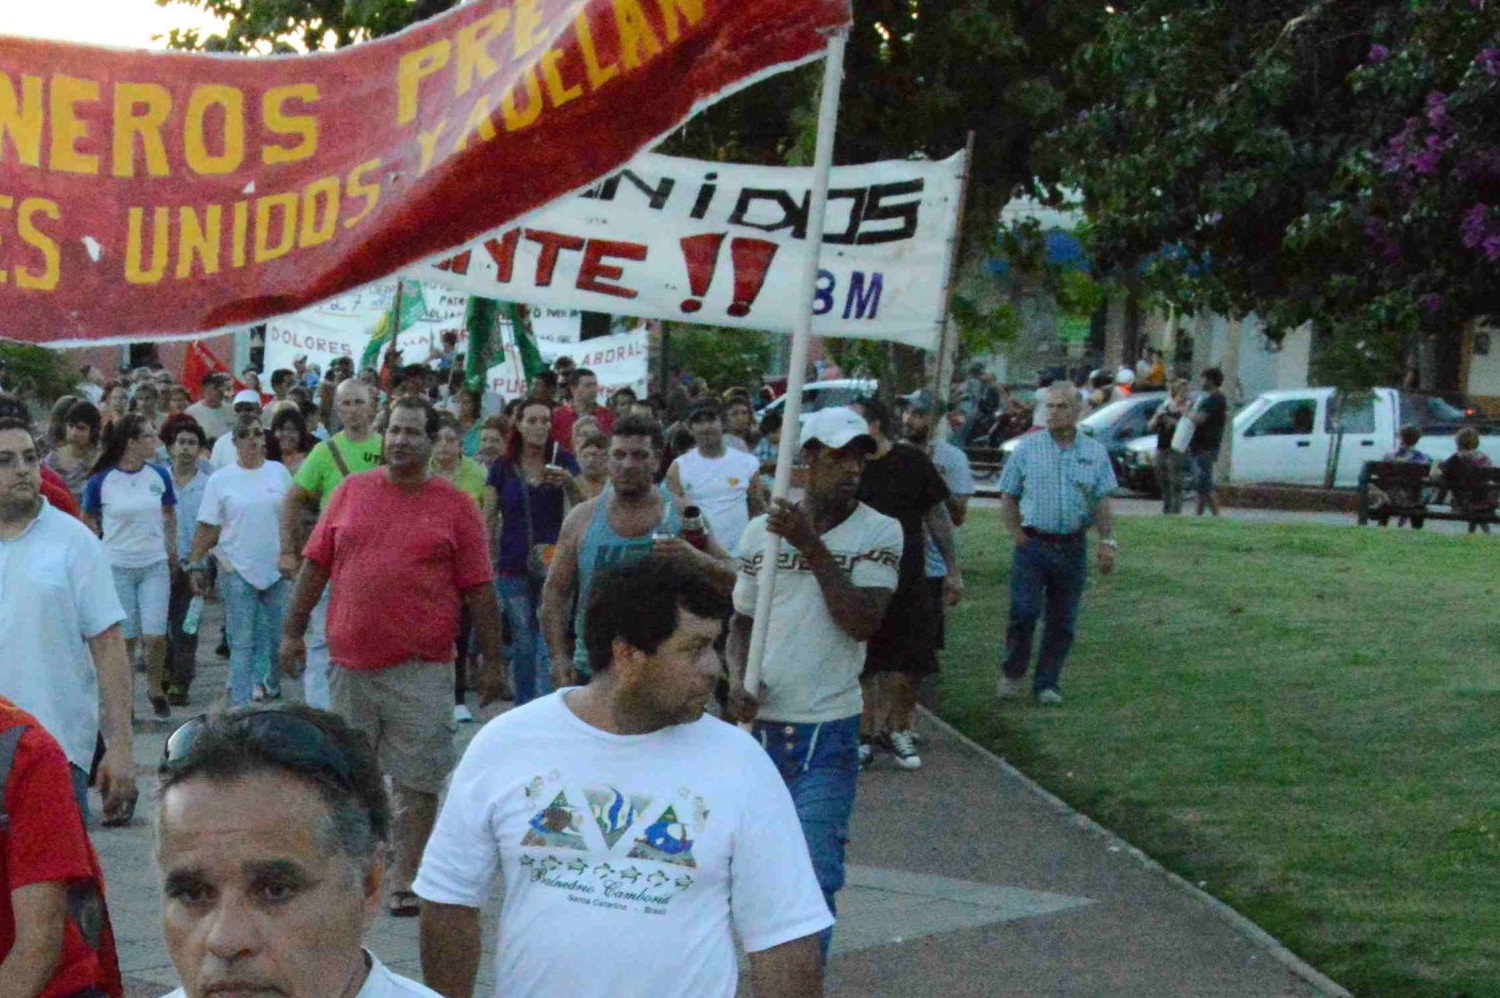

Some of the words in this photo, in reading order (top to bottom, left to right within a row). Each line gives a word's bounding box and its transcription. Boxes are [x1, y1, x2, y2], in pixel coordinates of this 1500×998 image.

[124, 158, 382, 285] UNIDOS
[271, 327, 352, 357] DOLORES
[567, 894, 591, 905] Santa
[593, 899, 628, 911] Catarina
[643, 906, 668, 916] Brasil
